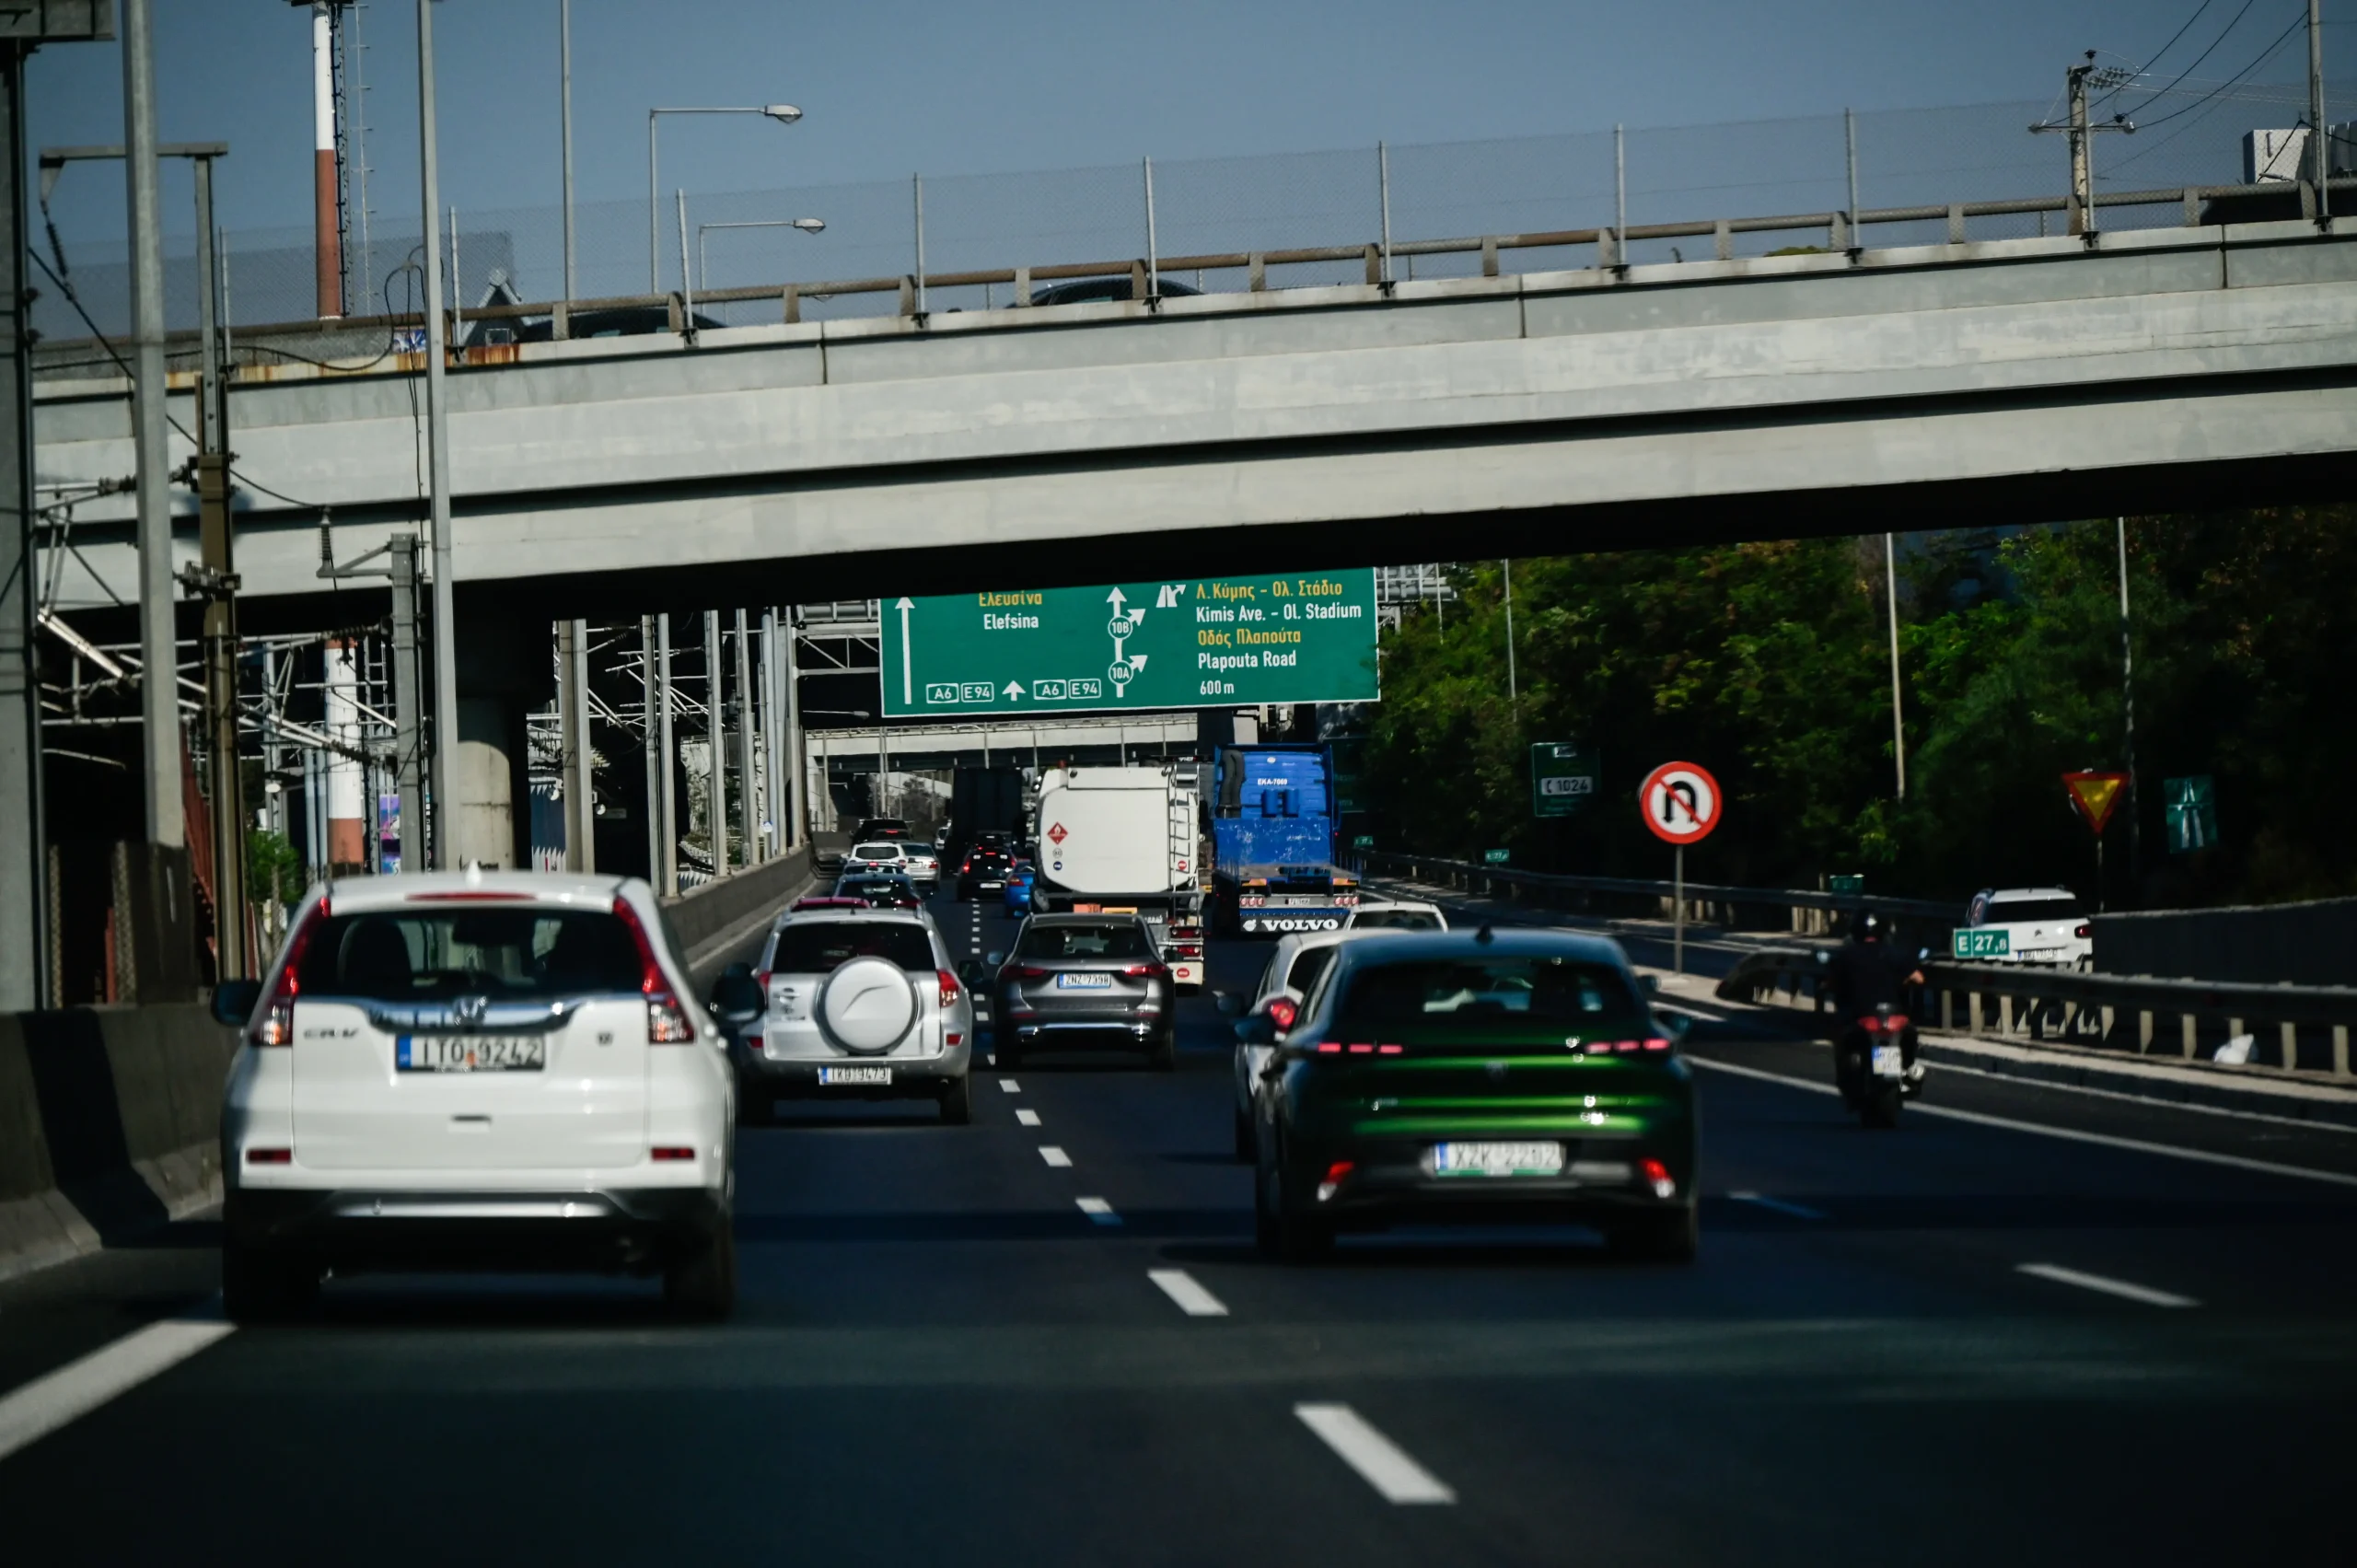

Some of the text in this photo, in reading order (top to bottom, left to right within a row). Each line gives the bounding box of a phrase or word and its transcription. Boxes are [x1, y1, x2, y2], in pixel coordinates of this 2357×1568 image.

[1213, 581, 1255, 601] Κύμης
[1298, 578, 1342, 597] Στάδιο
[979, 590, 1042, 607] Ελευσίνα
[1196, 604, 1235, 622] Kimis
[1238, 604, 1266, 621] Ave.
[1283, 603, 1301, 621] Ol.
[1306, 602, 1362, 620] Stadium
[983, 612, 1039, 630] Elefsina
[1111, 621, 1130, 634] 10B
[1198, 627, 1301, 648] Οδός Πλαπούτα
[1198, 649, 1296, 673] Plapouta Road
[1111, 667, 1130, 679] 10A
[934, 687, 952, 700] A6
[1041, 683, 1060, 696] A6
[1200, 680, 1235, 695] 600 m
[1557, 779, 1588, 792] 1024
[1260, 919, 1339, 931] VOLVO
[1958, 934, 2007, 954] E 27,8
